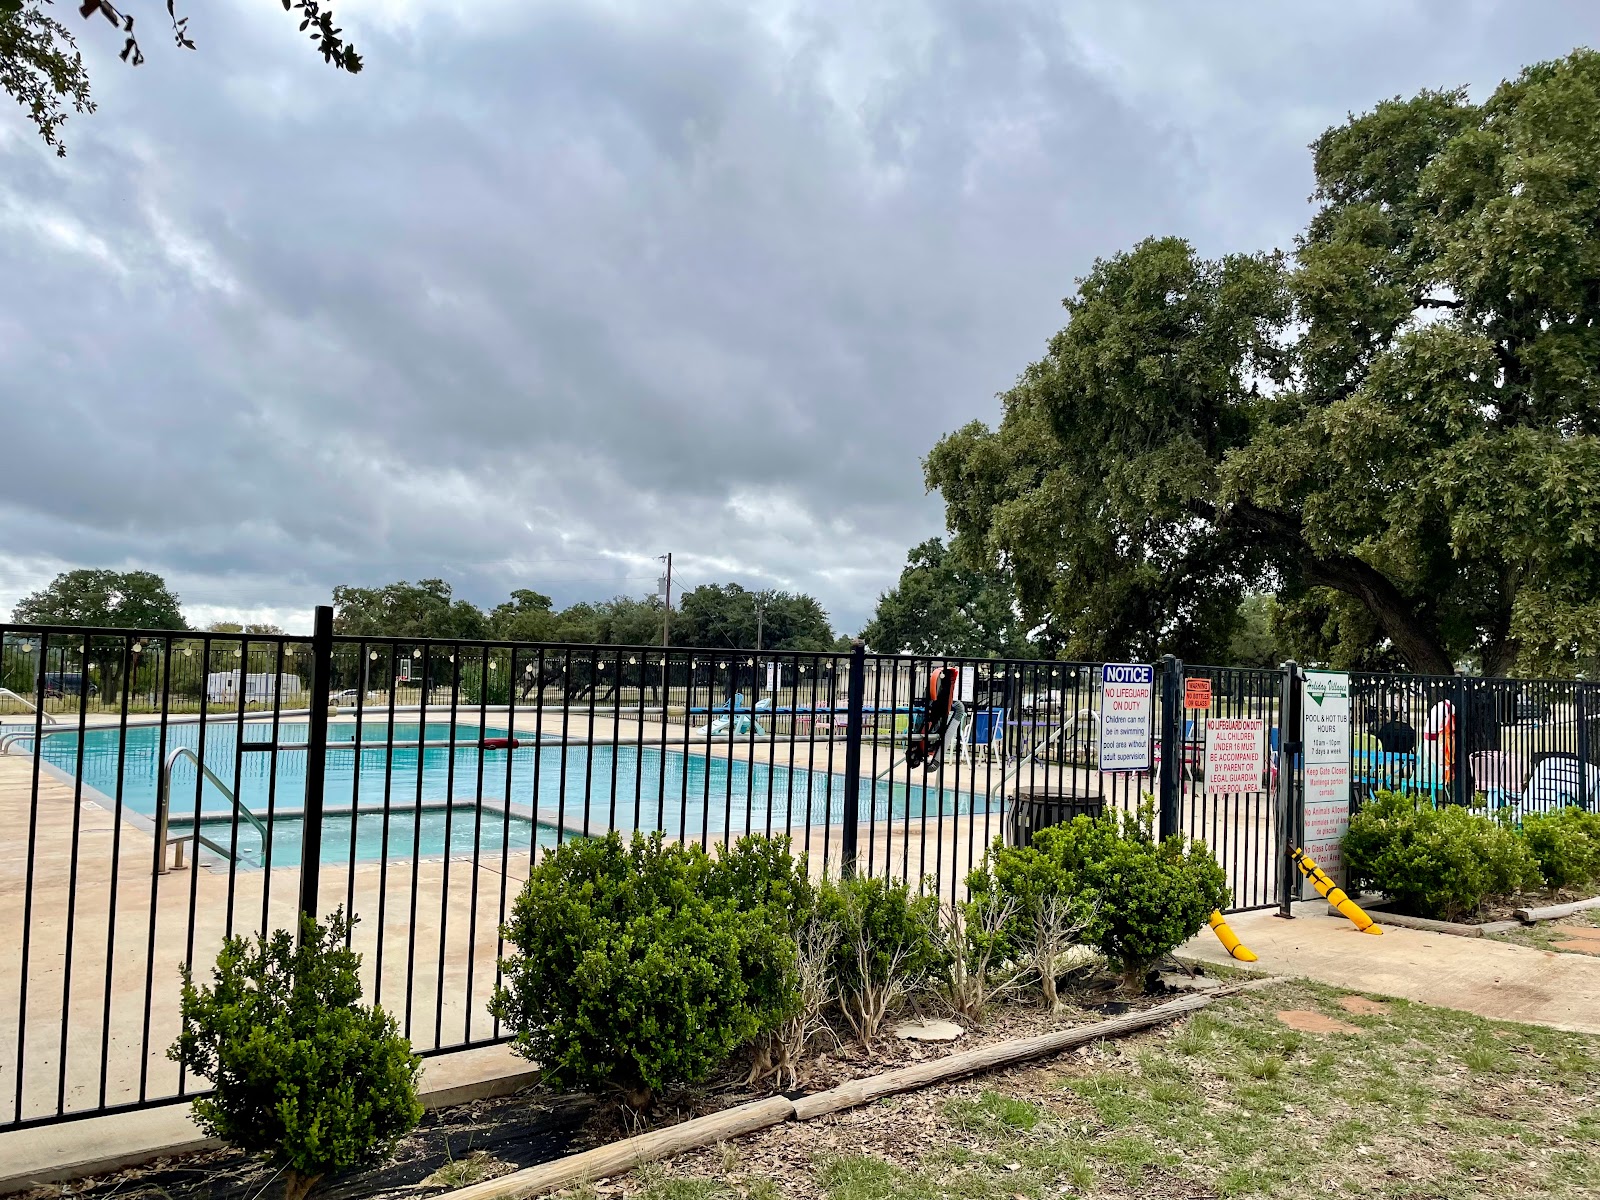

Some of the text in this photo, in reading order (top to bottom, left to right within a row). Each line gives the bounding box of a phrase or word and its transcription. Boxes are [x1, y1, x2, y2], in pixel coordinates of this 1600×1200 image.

[1107, 666, 1149, 682] NOTICE
[1105, 688, 1149, 698] NO LIFEGUARD
[1113, 701, 1140, 710] ON DUTY
[1207, 721, 1262, 730] NO LIFEGUARD ON DUTY
[1120, 728, 1144, 736] swimming
[1103, 741, 1114, 749] pool
[1103, 753, 1116, 761] adult
[1218, 753, 1258, 761] ACCOMPANIED
[1215, 764, 1223, 772] BY
[1307, 766, 1347, 776] Keep Gate Closed
[1210, 774, 1228, 782] LEGAL
[1227, 785, 1242, 793] POOL
[1312, 807, 1330, 815] Animals
